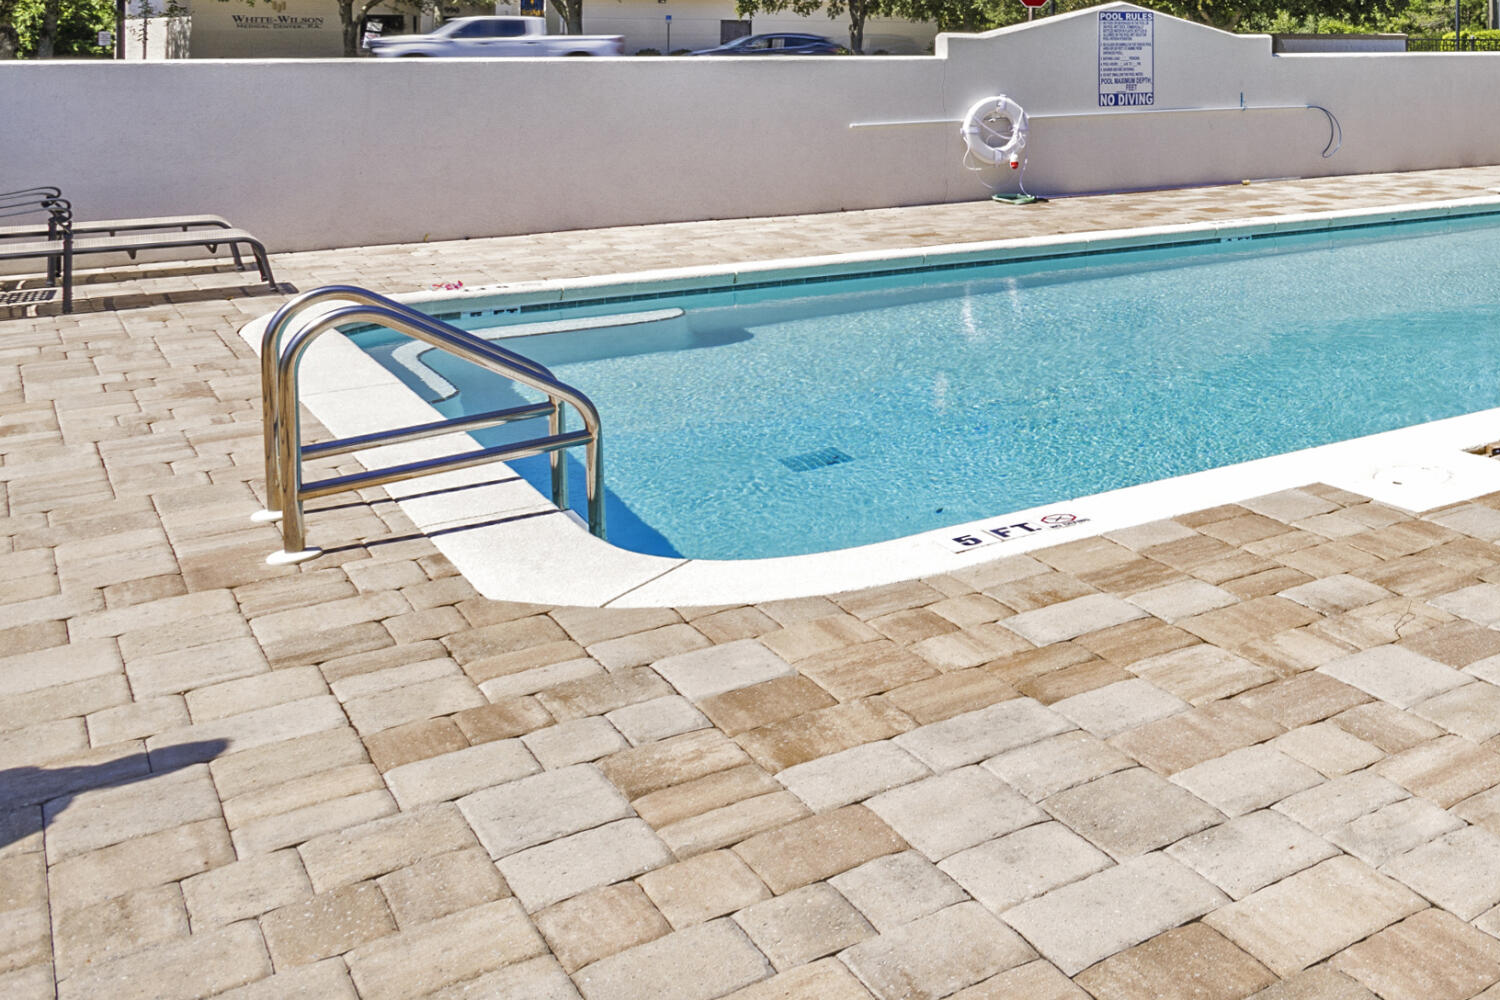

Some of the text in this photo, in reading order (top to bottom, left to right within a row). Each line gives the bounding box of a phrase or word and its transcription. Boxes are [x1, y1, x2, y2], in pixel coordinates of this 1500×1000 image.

[1100, 12, 1153, 20] POOL RULES
[1101, 93, 1153, 106] NO DIVING
[951, 534, 983, 546] 5
[989, 522, 1042, 538] FT.
